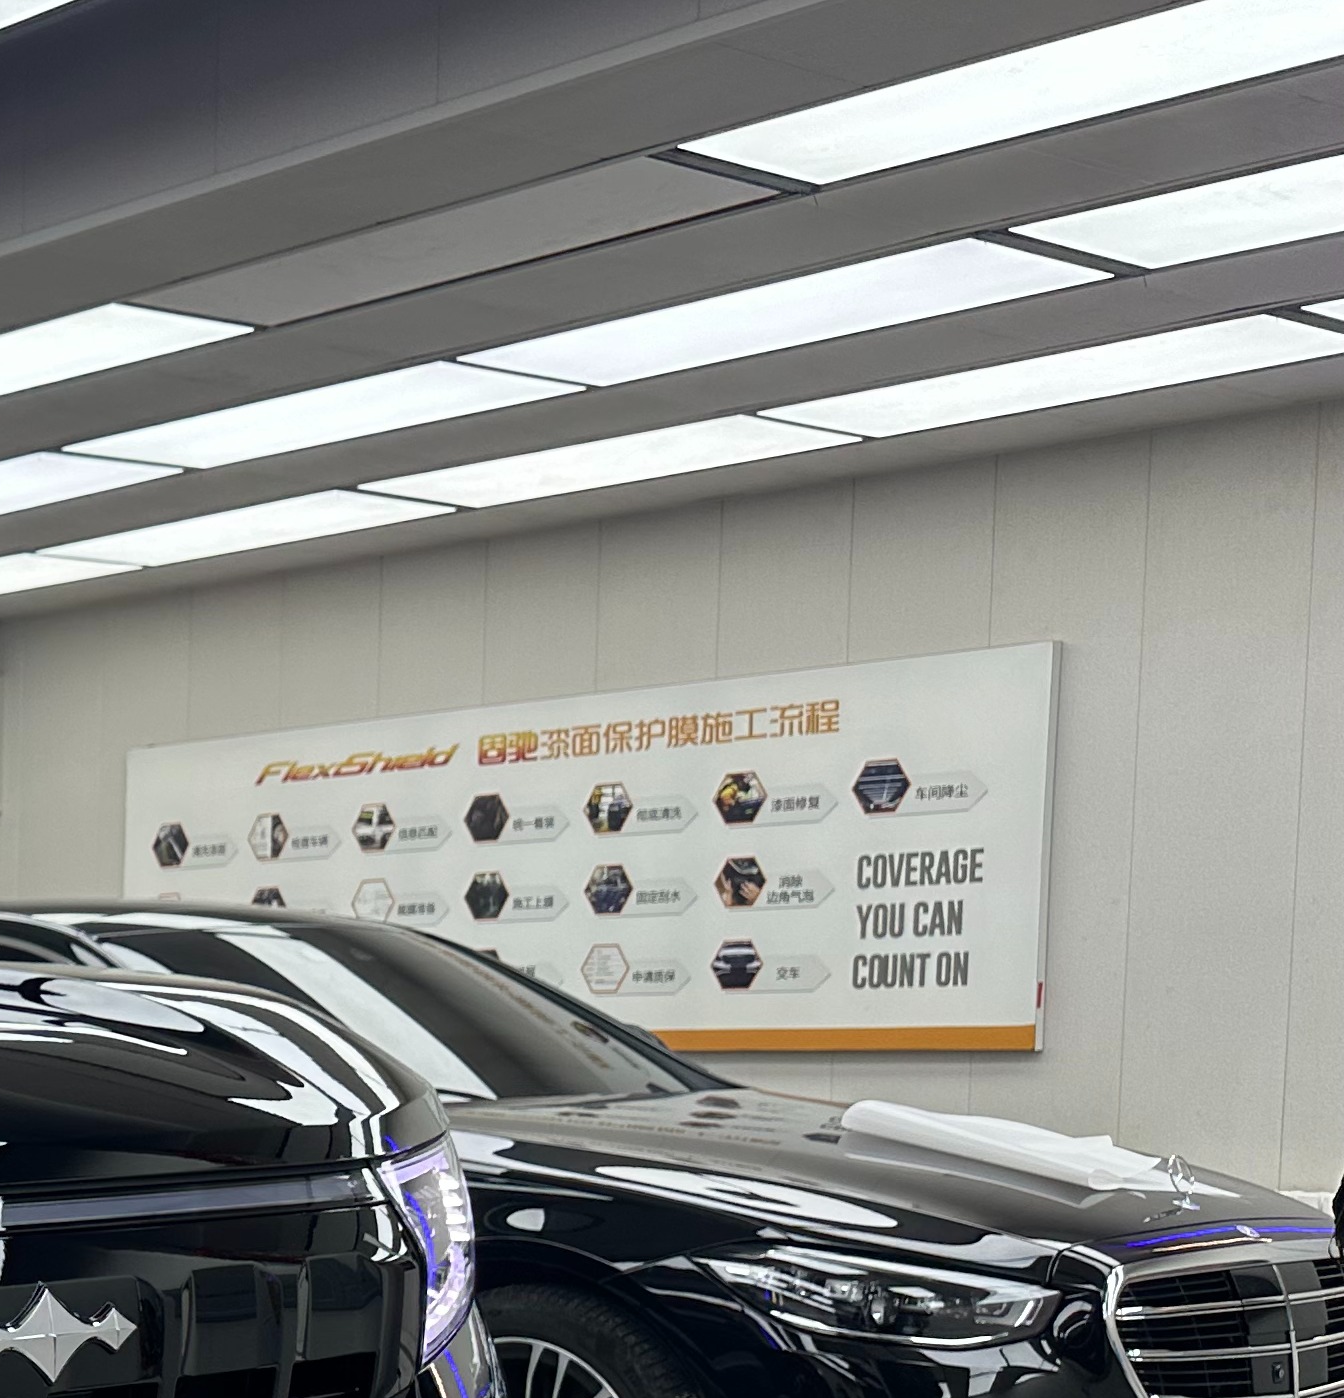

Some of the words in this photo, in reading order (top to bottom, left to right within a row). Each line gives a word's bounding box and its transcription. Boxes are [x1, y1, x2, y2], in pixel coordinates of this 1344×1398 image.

[856, 848, 985, 889] COVERAGE
[856, 902, 905, 940] YOU
[912, 899, 964, 937] CAN
[776, 966, 801, 981] 交车
[852, 952, 932, 990] COUNT
[936, 951, 970, 987] ON
